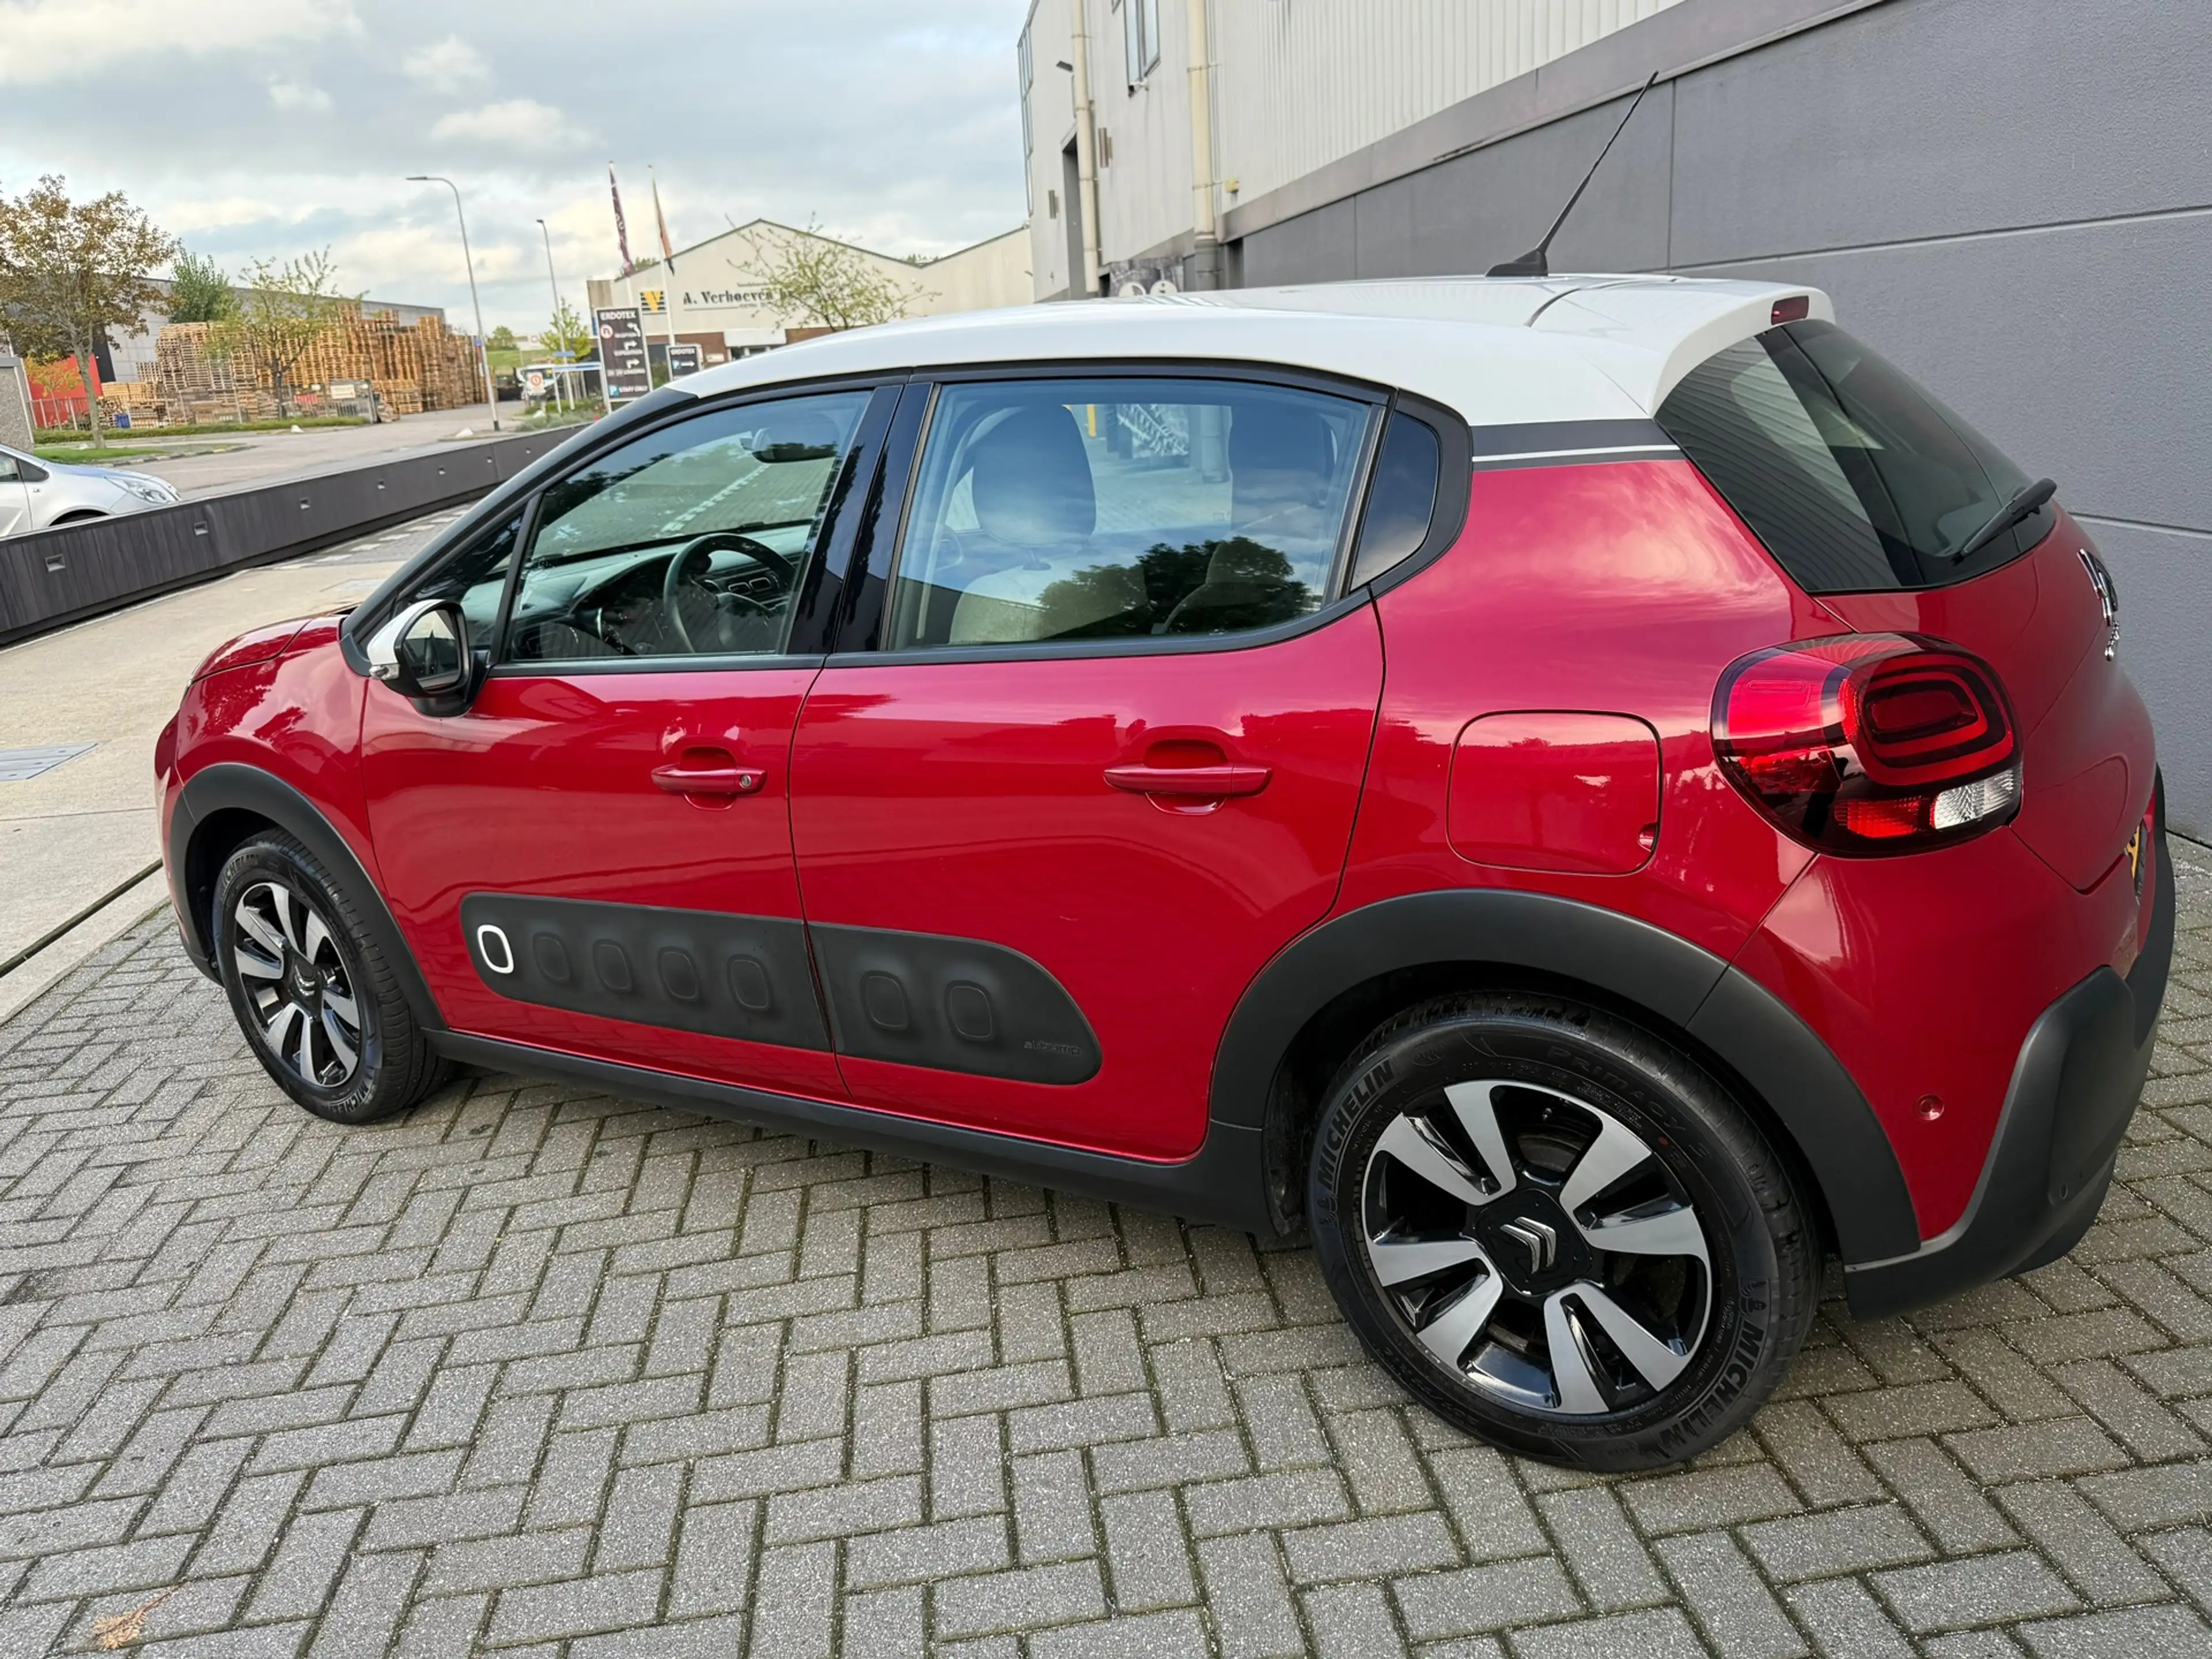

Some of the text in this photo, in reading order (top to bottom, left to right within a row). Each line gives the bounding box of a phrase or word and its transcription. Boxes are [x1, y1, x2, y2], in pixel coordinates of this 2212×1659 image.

[683, 291, 698, 305] A.
[701, 289, 773, 304] Verhoeven
[1317, 1059, 1395, 1191] MICHELIN
[1547, 1046, 1686, 1130] PRIMACY
[1659, 1319, 1764, 1448] MICHELIN
